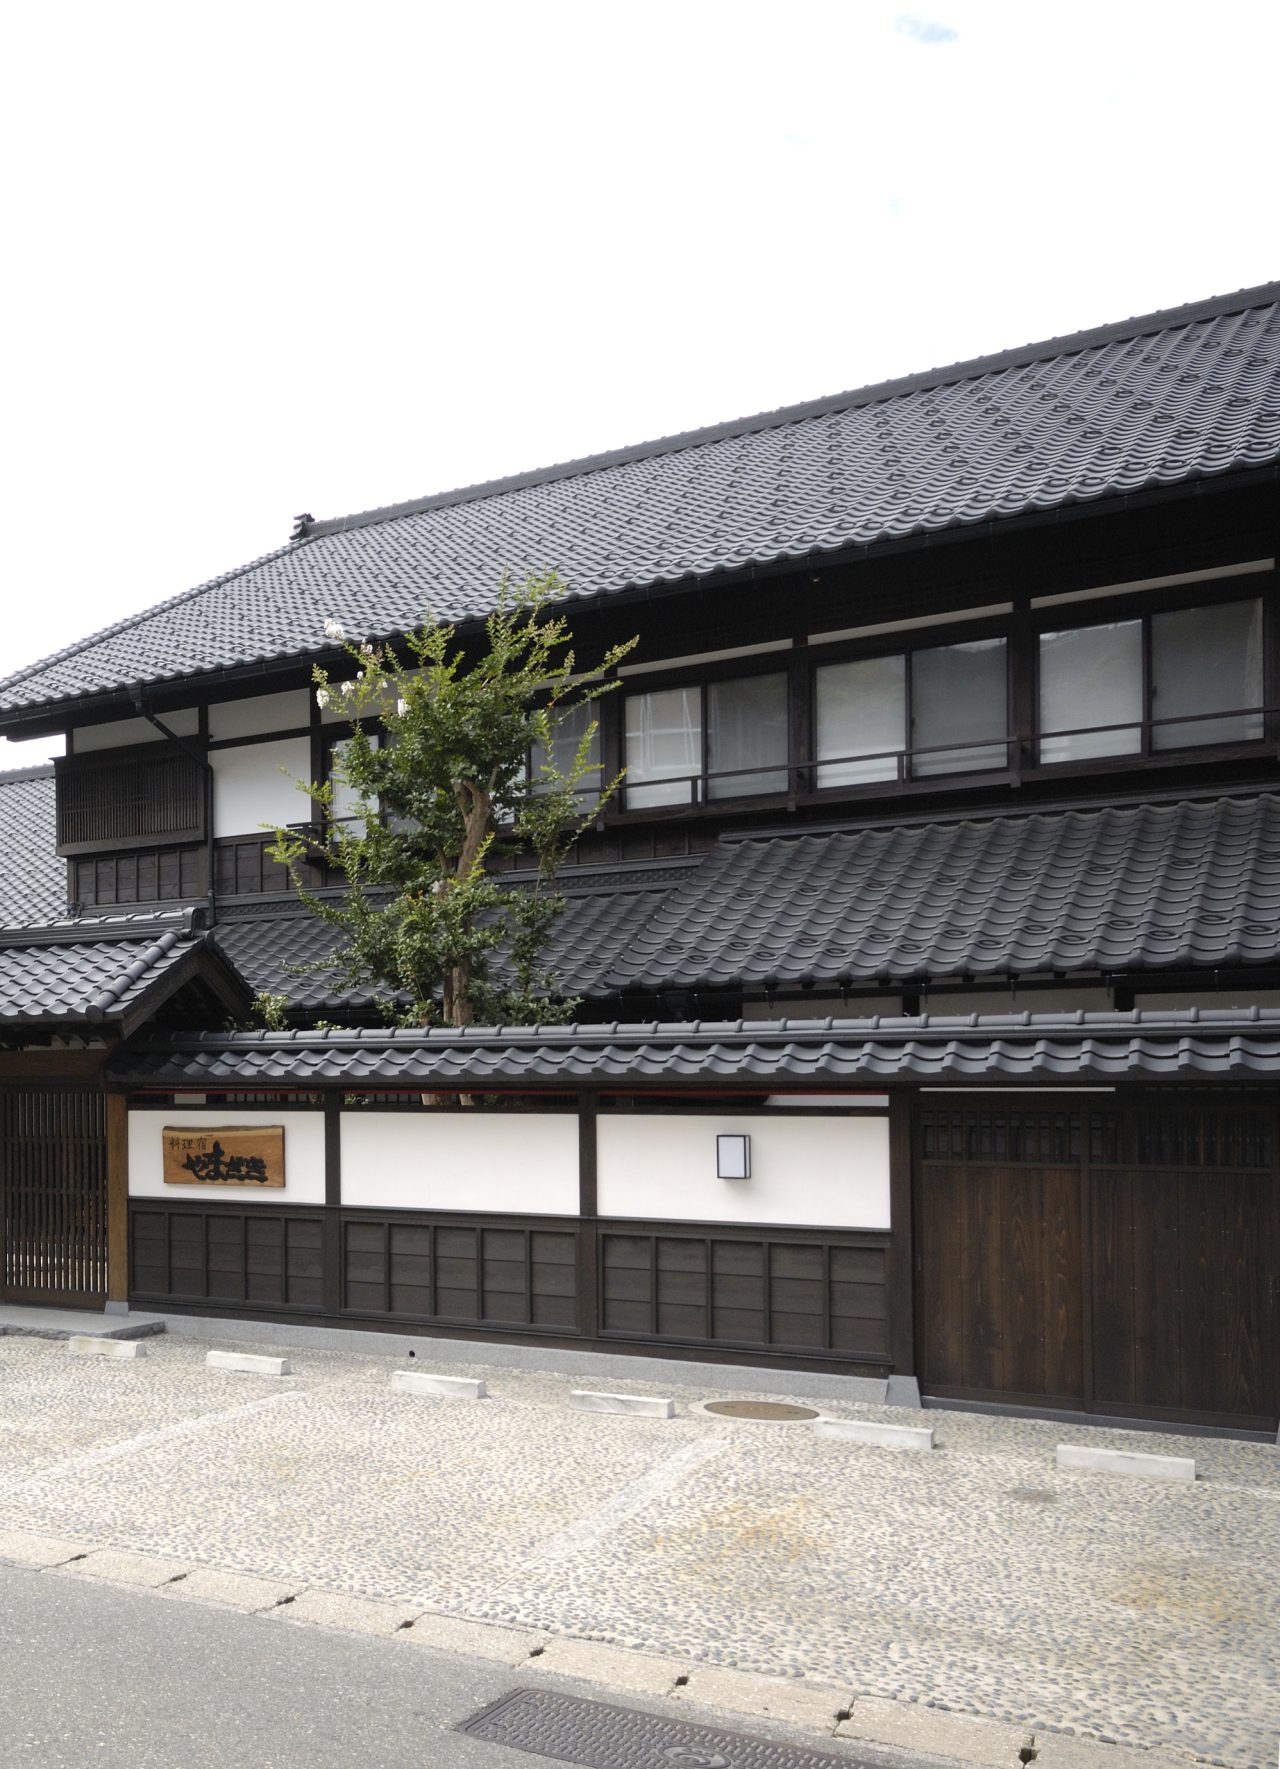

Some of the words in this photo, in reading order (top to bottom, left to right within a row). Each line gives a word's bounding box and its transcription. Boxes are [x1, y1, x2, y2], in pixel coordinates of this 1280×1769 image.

[169, 1136, 207, 1151] 料理宿
[181, 1140, 269, 1183] やまざき
